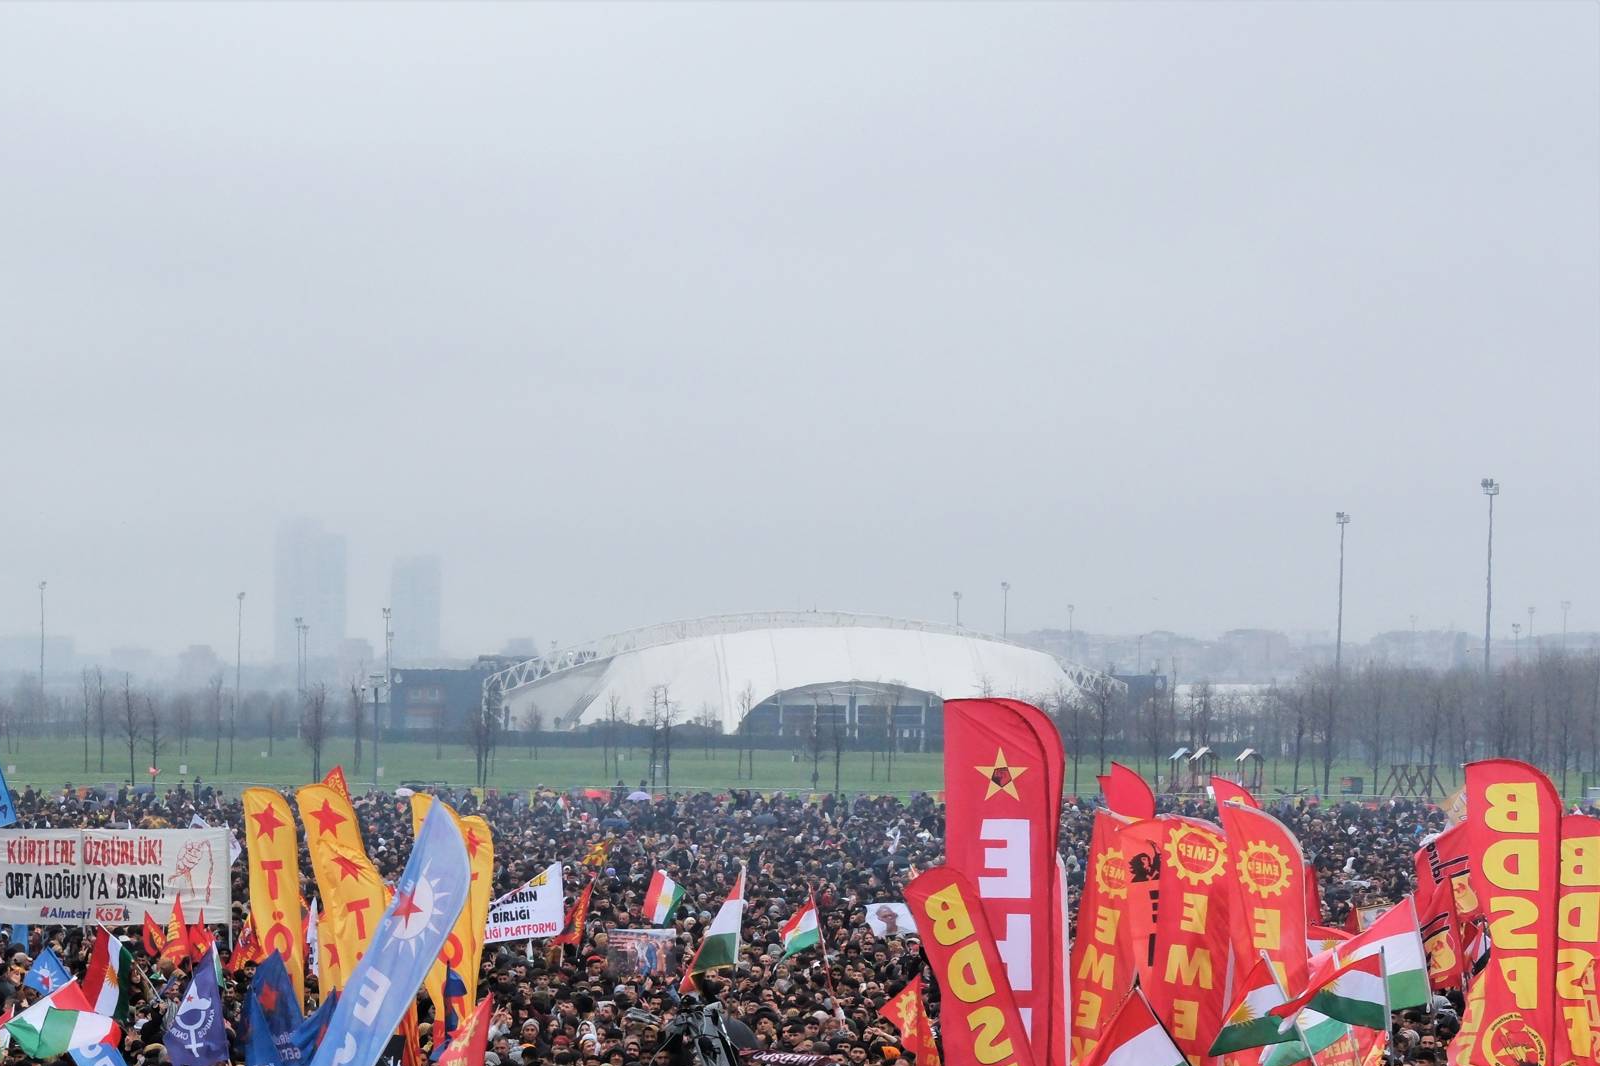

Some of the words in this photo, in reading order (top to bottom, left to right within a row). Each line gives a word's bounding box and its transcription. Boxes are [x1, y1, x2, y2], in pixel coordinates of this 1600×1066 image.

[7, 836, 76, 866] KÜRTLERE
[83, 835, 163, 866] ÖZGÜRLÜK!
[5, 870, 108, 900] ORTADOĞU'YA
[485, 924, 502, 939] LİĞİ
[504, 922, 557, 937] PLATFORMU
